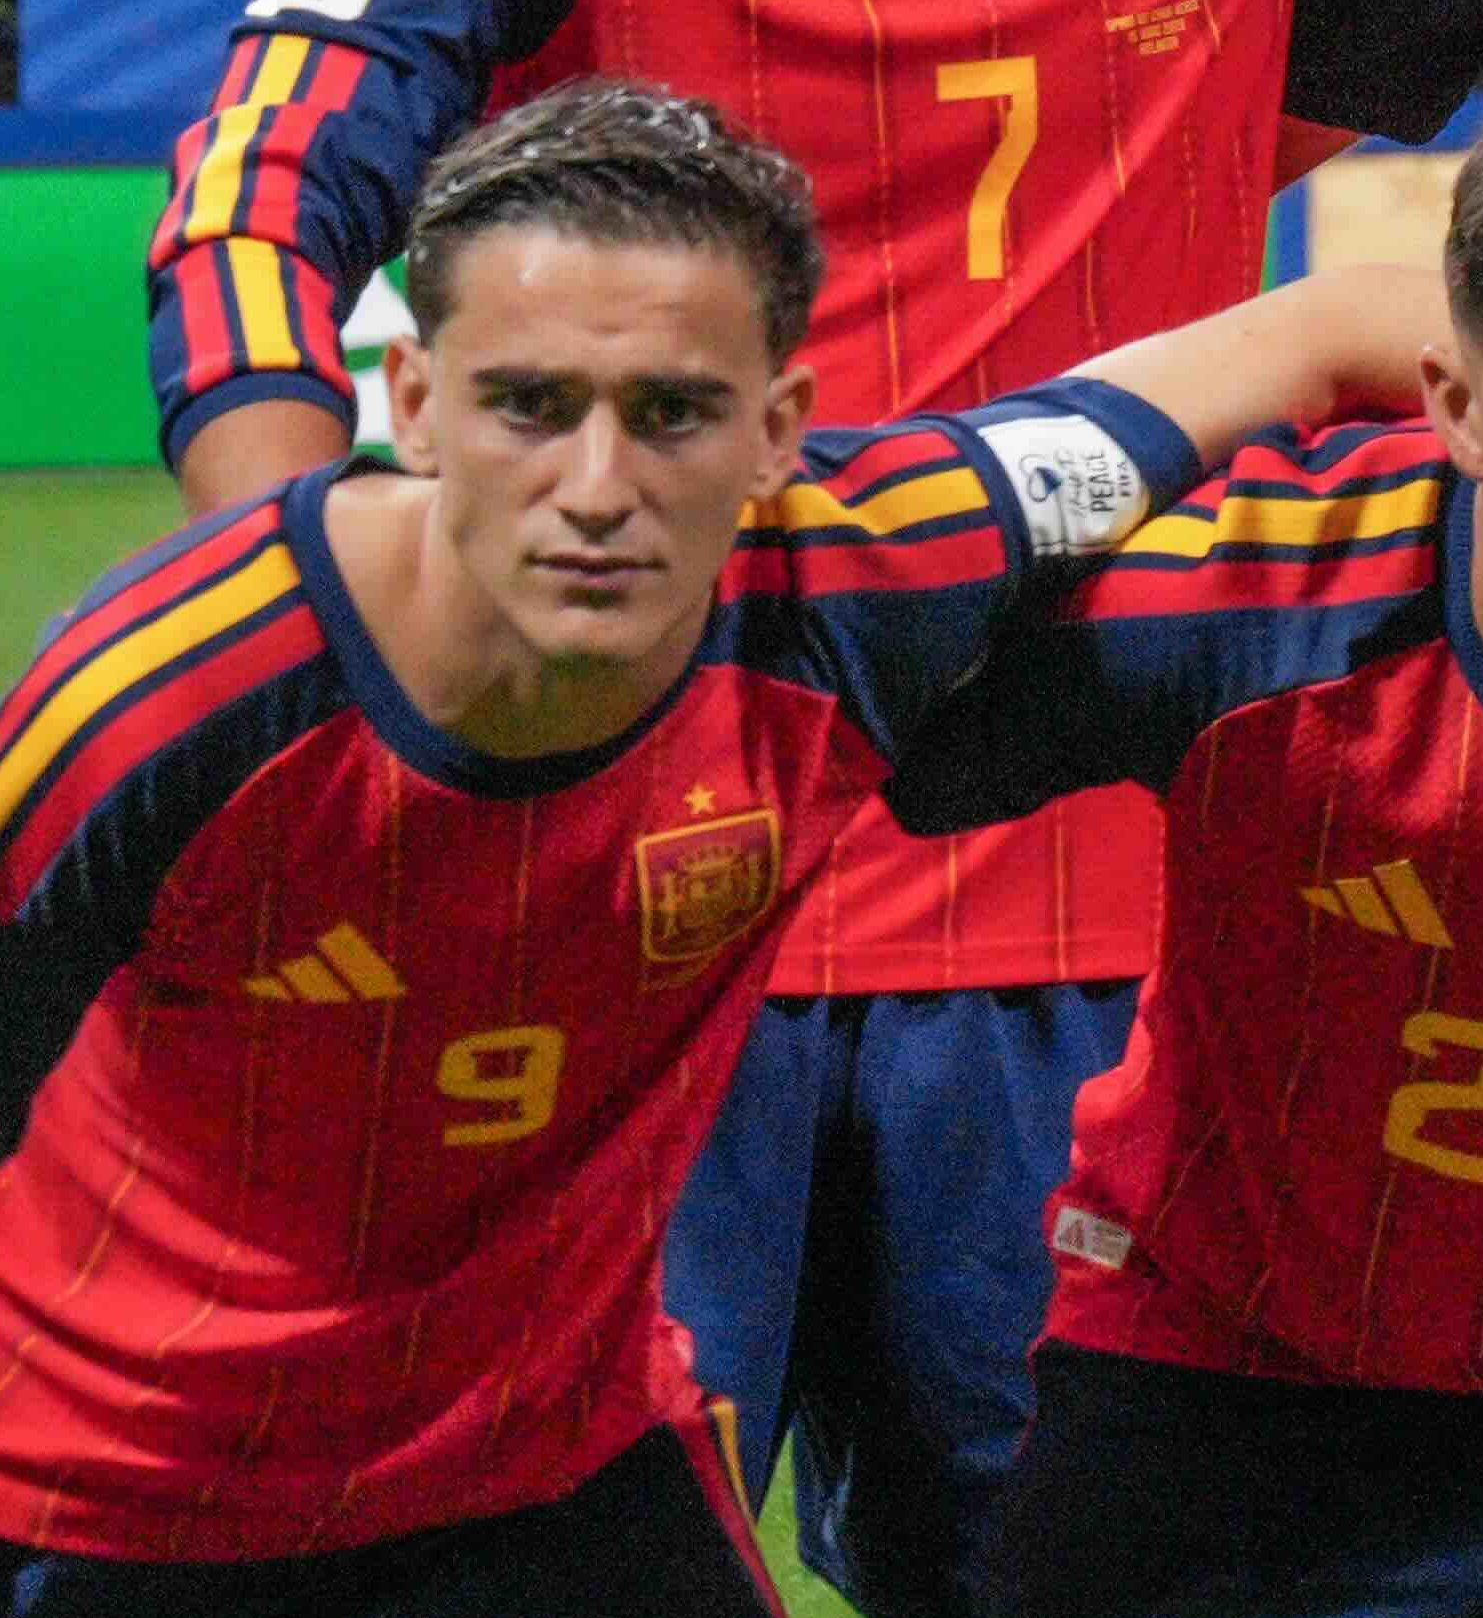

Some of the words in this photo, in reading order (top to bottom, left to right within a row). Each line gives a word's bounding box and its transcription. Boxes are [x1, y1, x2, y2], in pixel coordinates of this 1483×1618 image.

[936, 56, 1039, 280] 7
[1081, 448, 1116, 511] PEACE
[436, 1025, 565, 1147] 9
